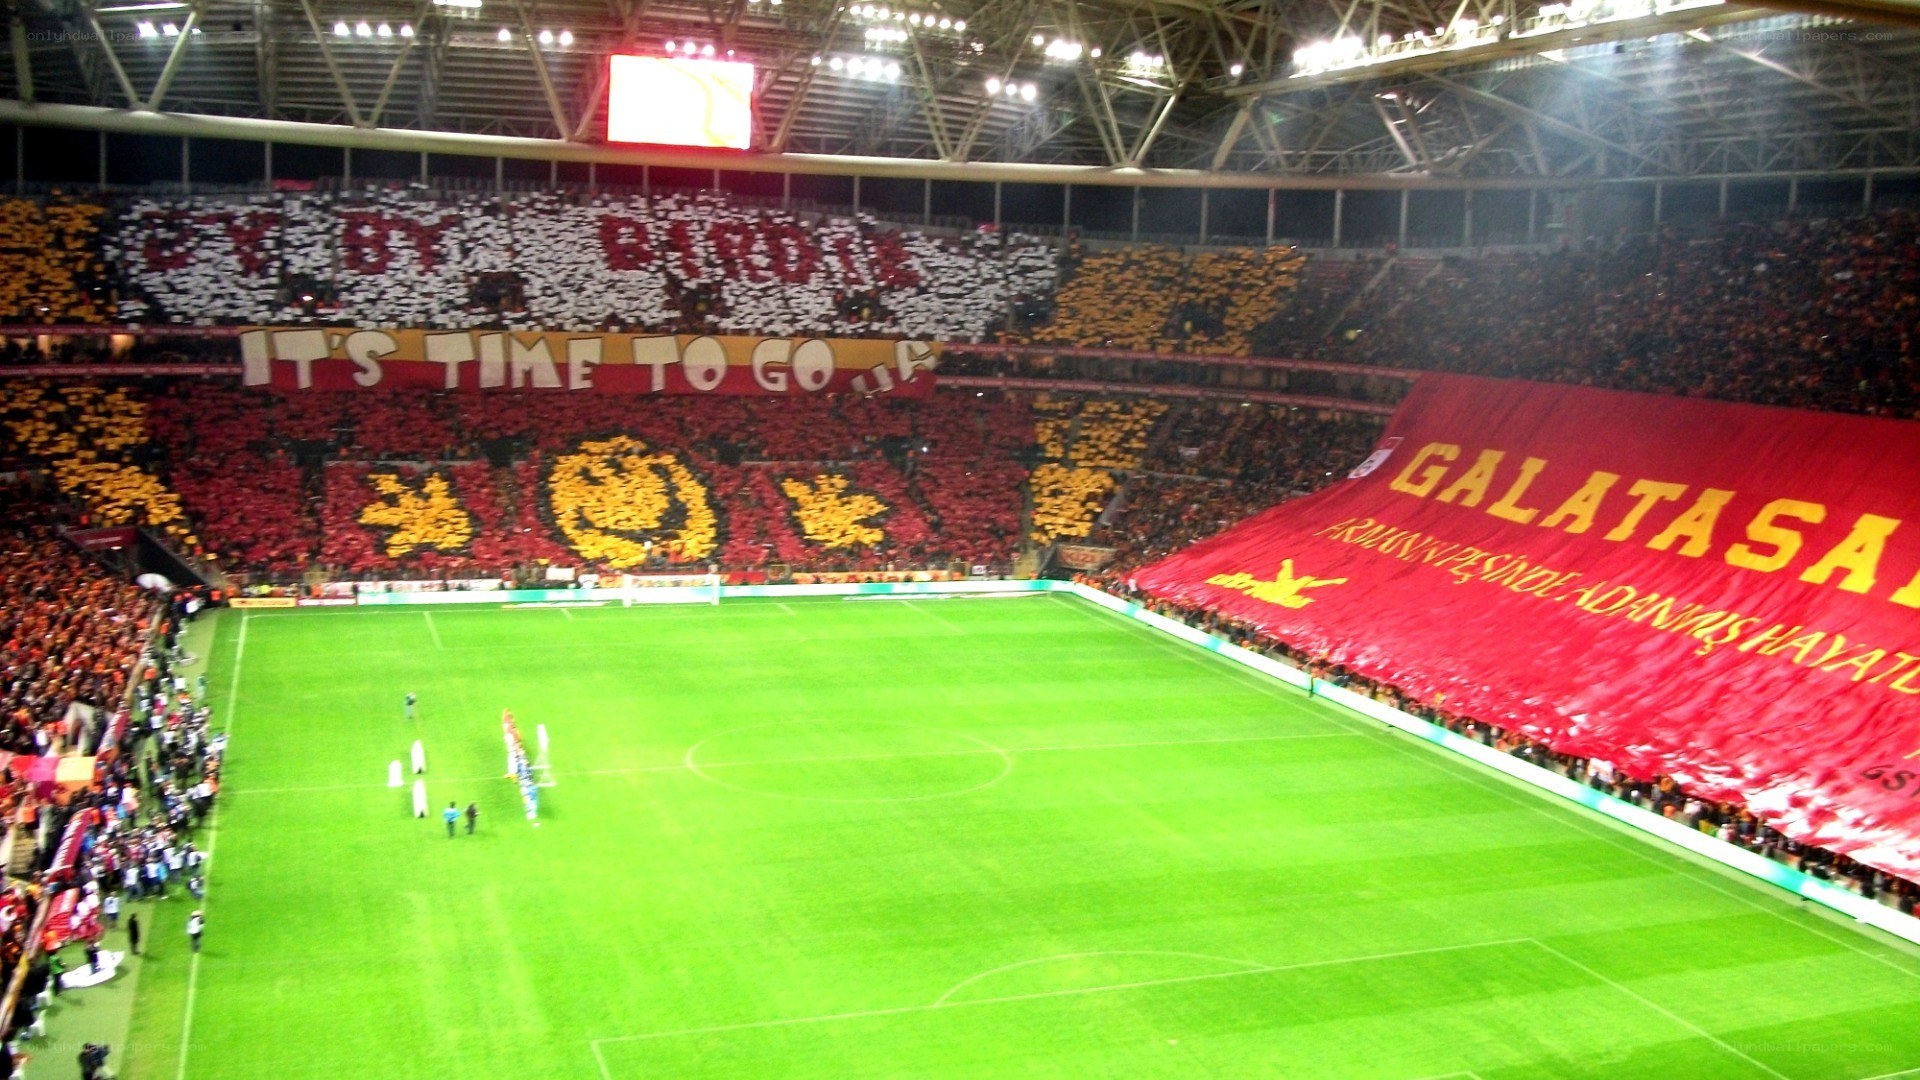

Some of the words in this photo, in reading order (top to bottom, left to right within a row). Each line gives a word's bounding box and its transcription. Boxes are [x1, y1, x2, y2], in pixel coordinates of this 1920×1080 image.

[240, 328, 398, 389] IT'S
[423, 330, 602, 391] TIME
[632, 334, 729, 392] TO
[751, 337, 836, 392] GO
[1861, 764, 1920, 798] GS
